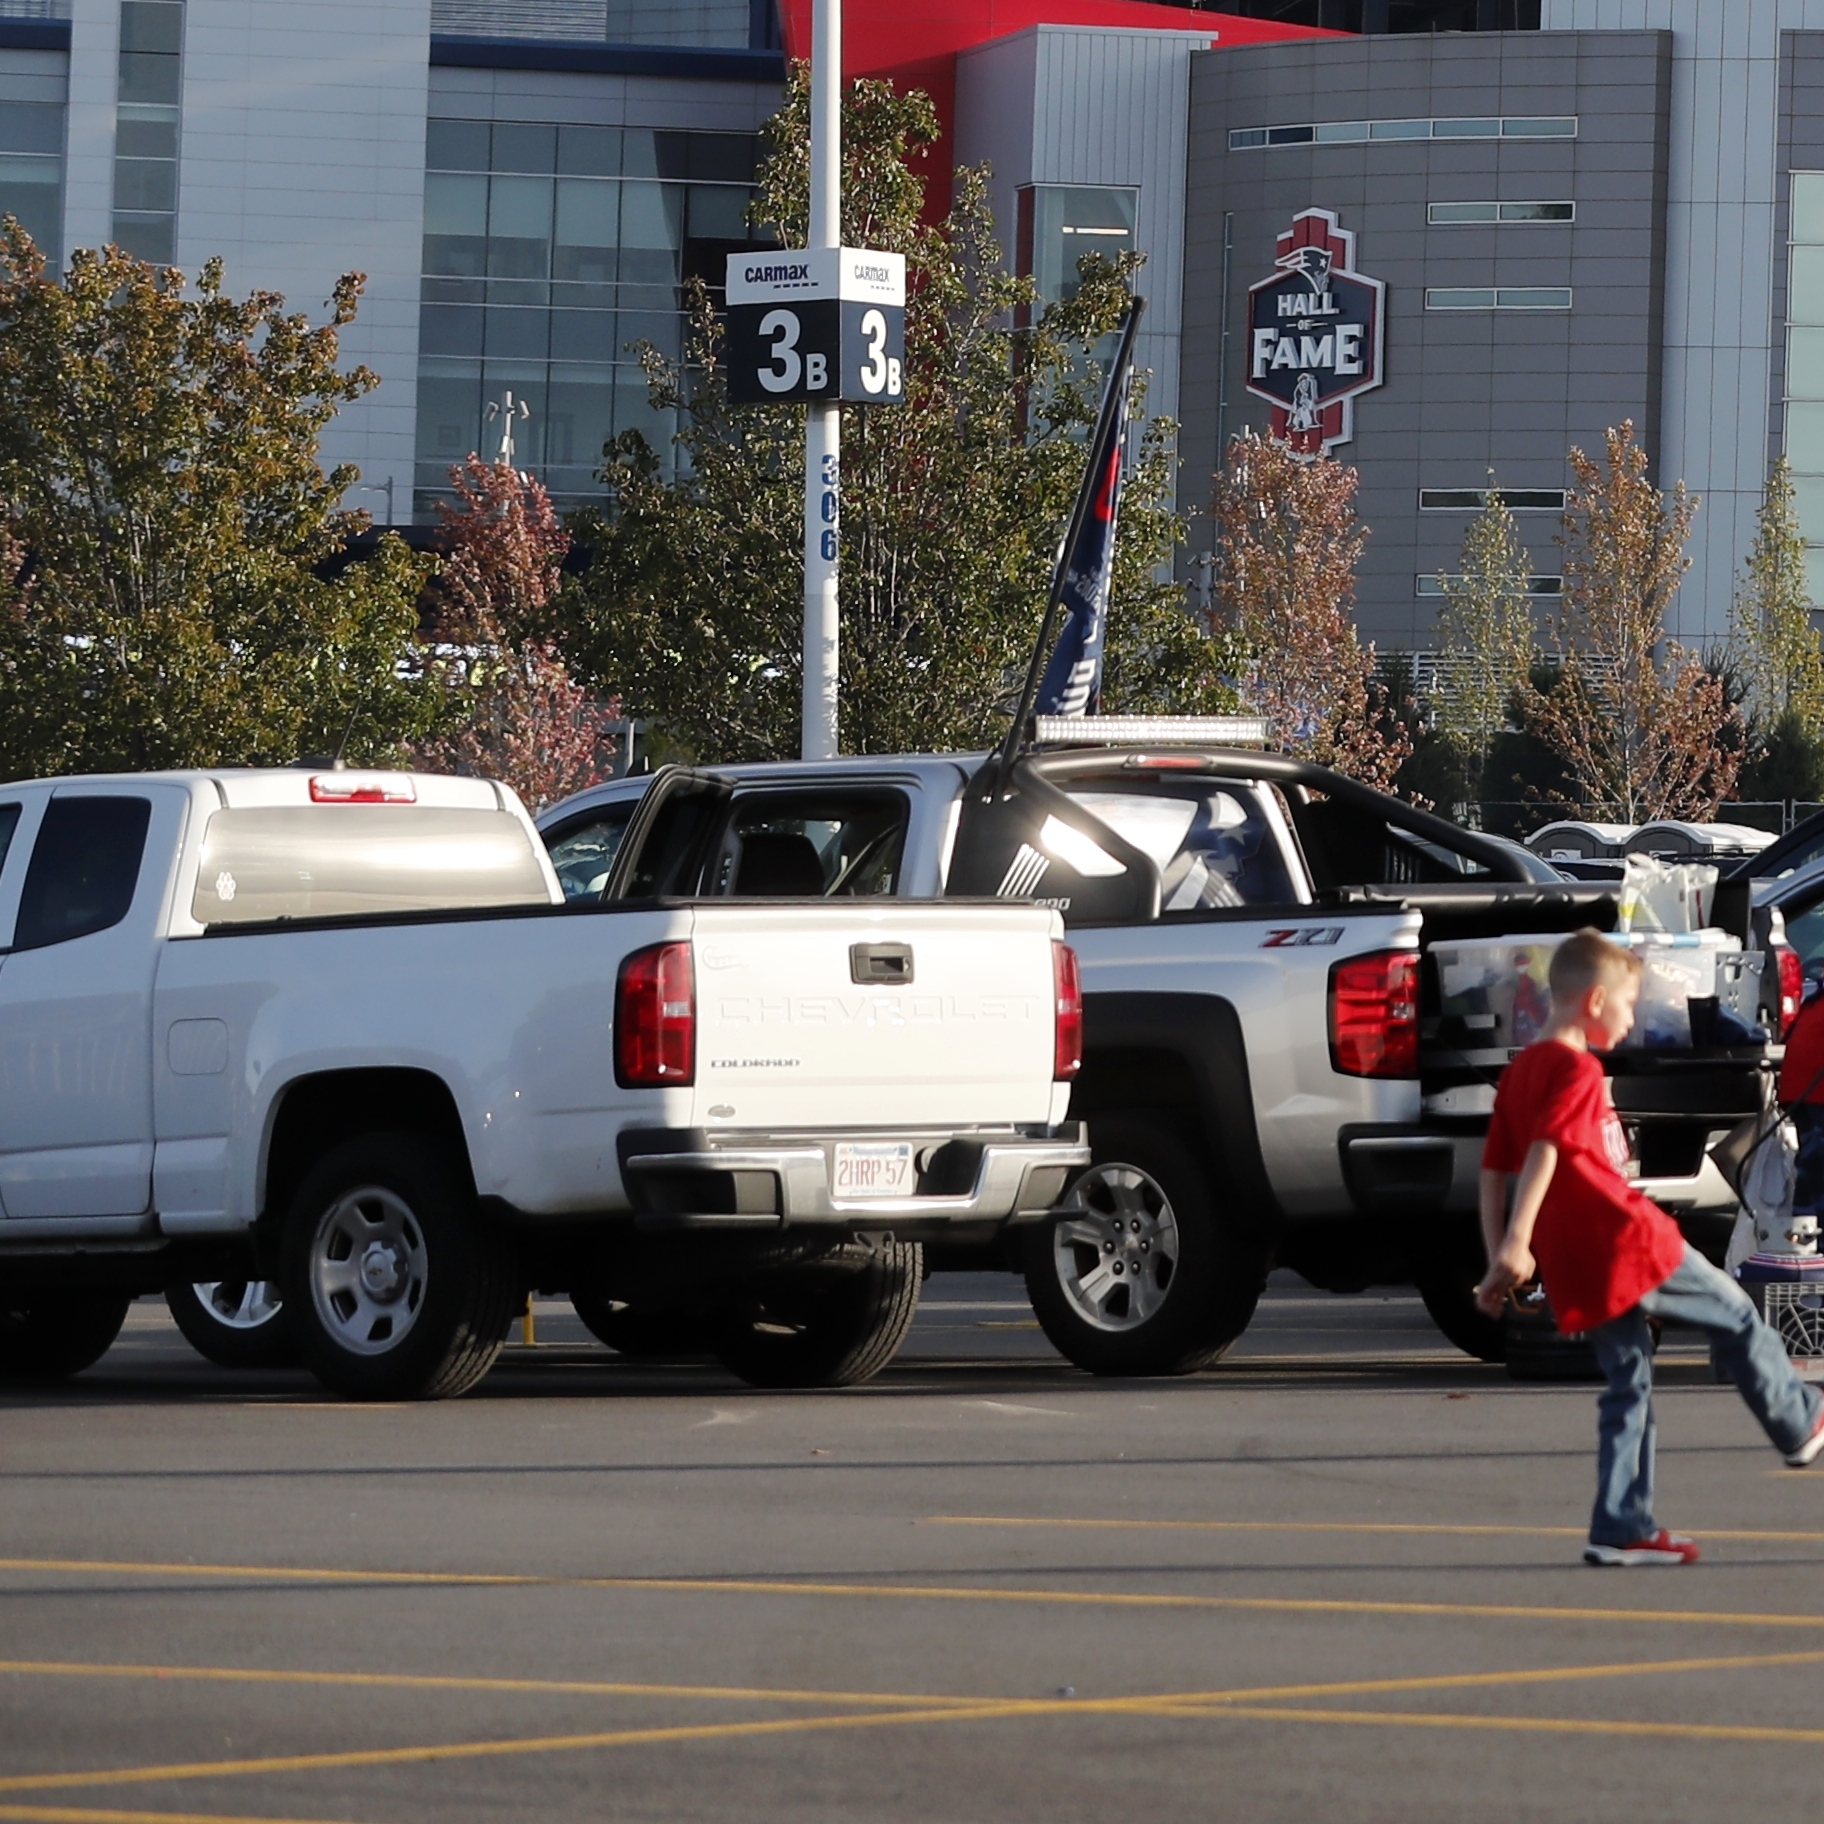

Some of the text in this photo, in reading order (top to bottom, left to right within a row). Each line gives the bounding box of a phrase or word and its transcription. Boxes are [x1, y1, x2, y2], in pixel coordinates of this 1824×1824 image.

[1277, 292, 1340, 317] HALL
[1297, 319, 1312, 331] OF
[1252, 324, 1364, 378] FAME
[1258, 927, 1345, 948] Z71
[716, 994, 1042, 1025] CHEVROLET
[711, 1058, 801, 1069] COLORADO
[838, 1159, 908, 1186] 2HRP 57
